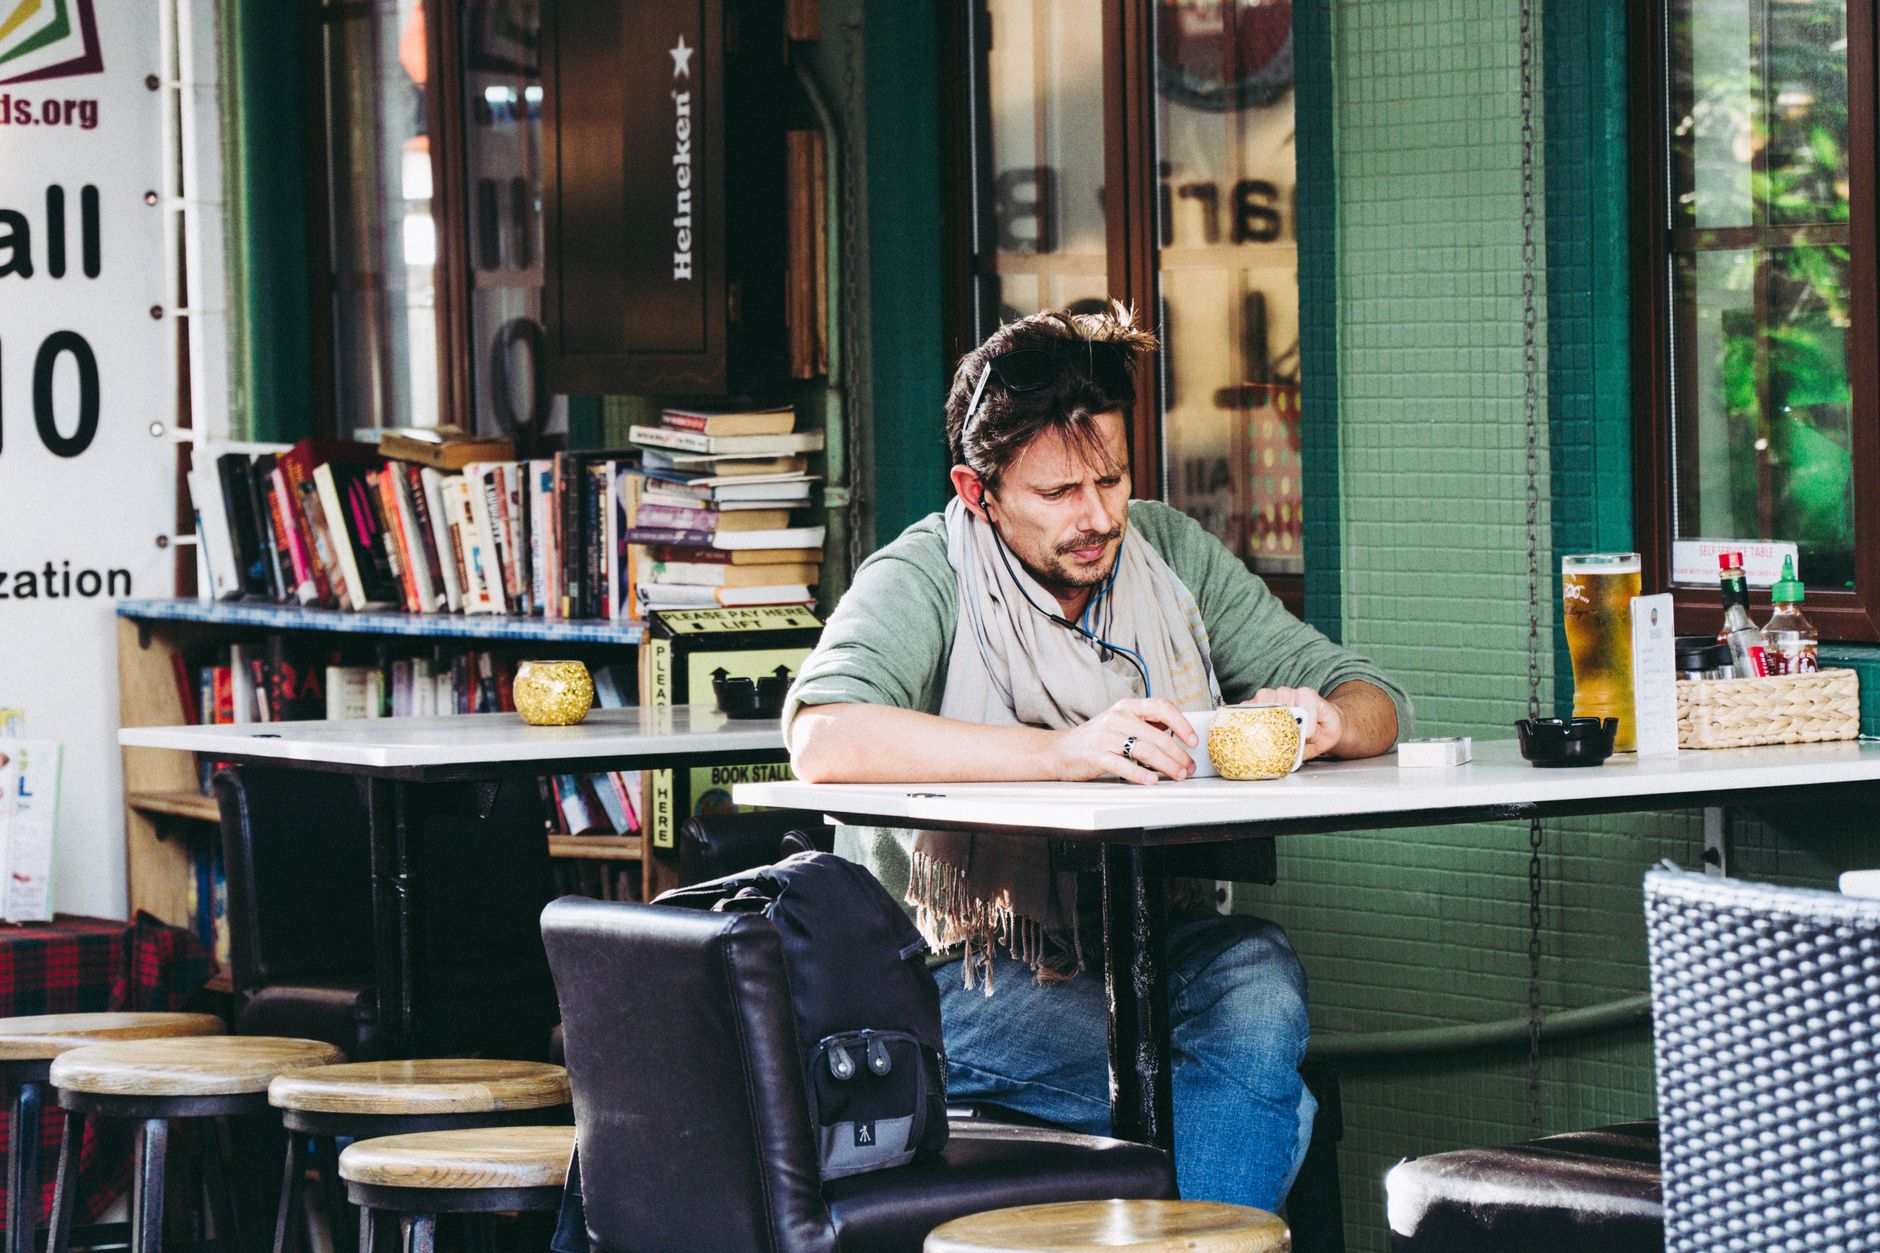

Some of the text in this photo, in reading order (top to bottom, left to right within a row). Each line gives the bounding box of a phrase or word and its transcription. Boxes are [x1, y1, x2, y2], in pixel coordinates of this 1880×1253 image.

[0, 94, 99, 130] ds.org
[671, 89, 692, 281] Heineken
[0, 184, 101, 280] all
[0, 330, 101, 458] 0
[1750, 546, 1774, 558] TABLE
[0, 561, 132, 599] zation
[662, 606, 809, 622] PLEASE PAY HERE
[720, 620, 763, 630] LIFT
[656, 646, 667, 707] PLEA
[711, 764, 792, 785] BOOK STALL
[657, 788, 668, 842] HERE
